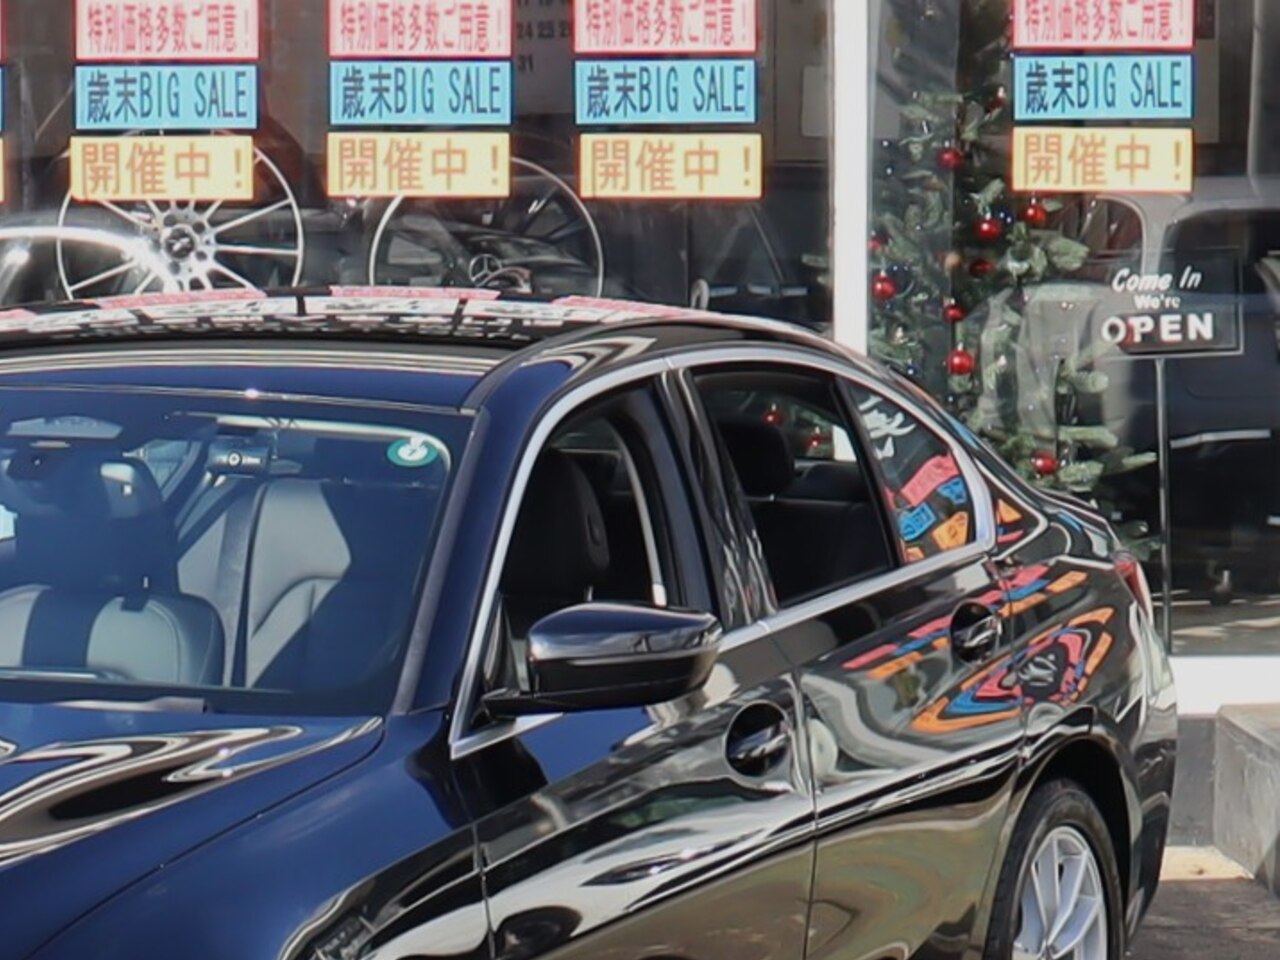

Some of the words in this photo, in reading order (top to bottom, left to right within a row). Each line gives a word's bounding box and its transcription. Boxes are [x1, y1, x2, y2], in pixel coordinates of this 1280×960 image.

[194, 71, 248, 118] SALE
[448, 67, 502, 114] SALE
[692, 65, 746, 112] SALE
[1131, 61, 1182, 108] SALE
[1112, 267, 1173, 292] Come
[1179, 265, 1202, 289] In
[1133, 293, 1181, 310] We're
[1101, 312, 1213, 344] OPEN
